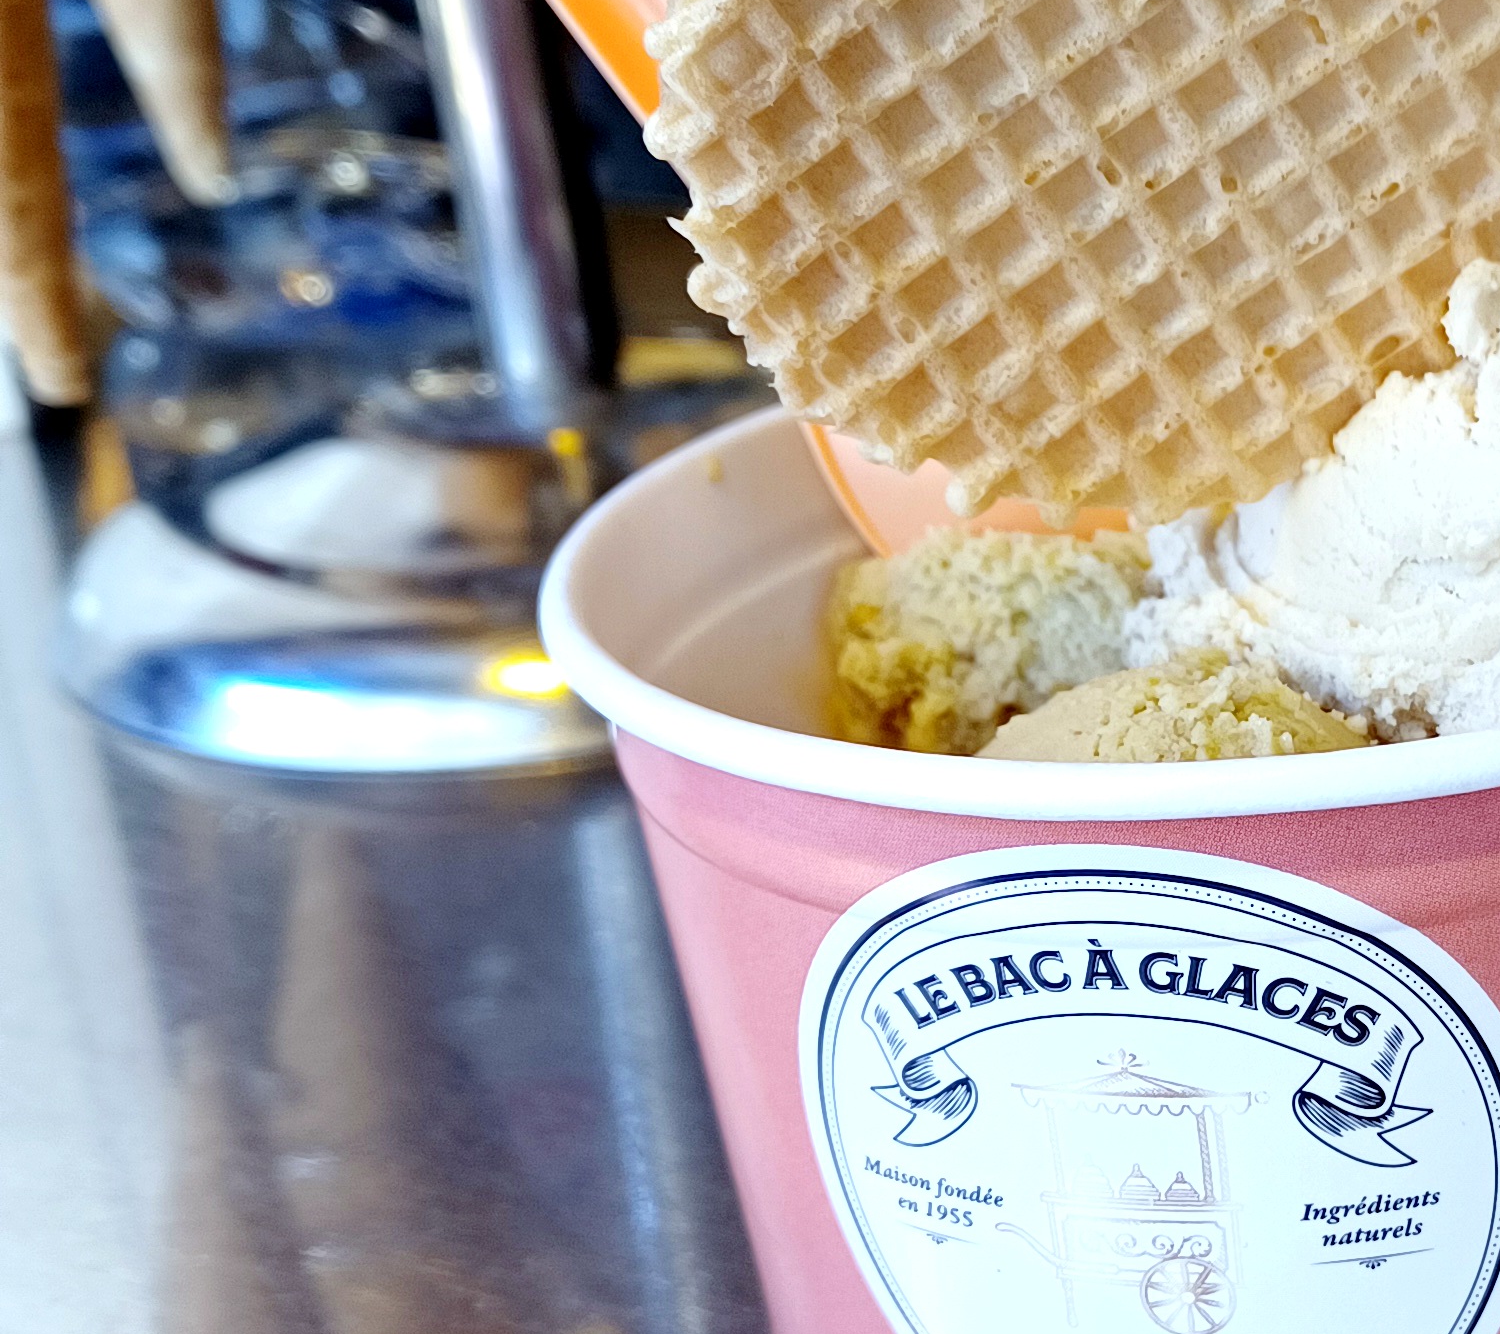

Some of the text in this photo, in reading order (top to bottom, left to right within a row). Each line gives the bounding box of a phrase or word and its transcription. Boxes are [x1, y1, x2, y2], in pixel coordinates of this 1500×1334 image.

[894, 938, 1384, 1047] LE BAC À GLACES
[864, 1155, 1004, 1208] Maison fondée
[898, 1196, 974, 1228] en 1955
[1299, 1190, 1441, 1225] Ingrédients
[1322, 1217, 1424, 1247] naturels
